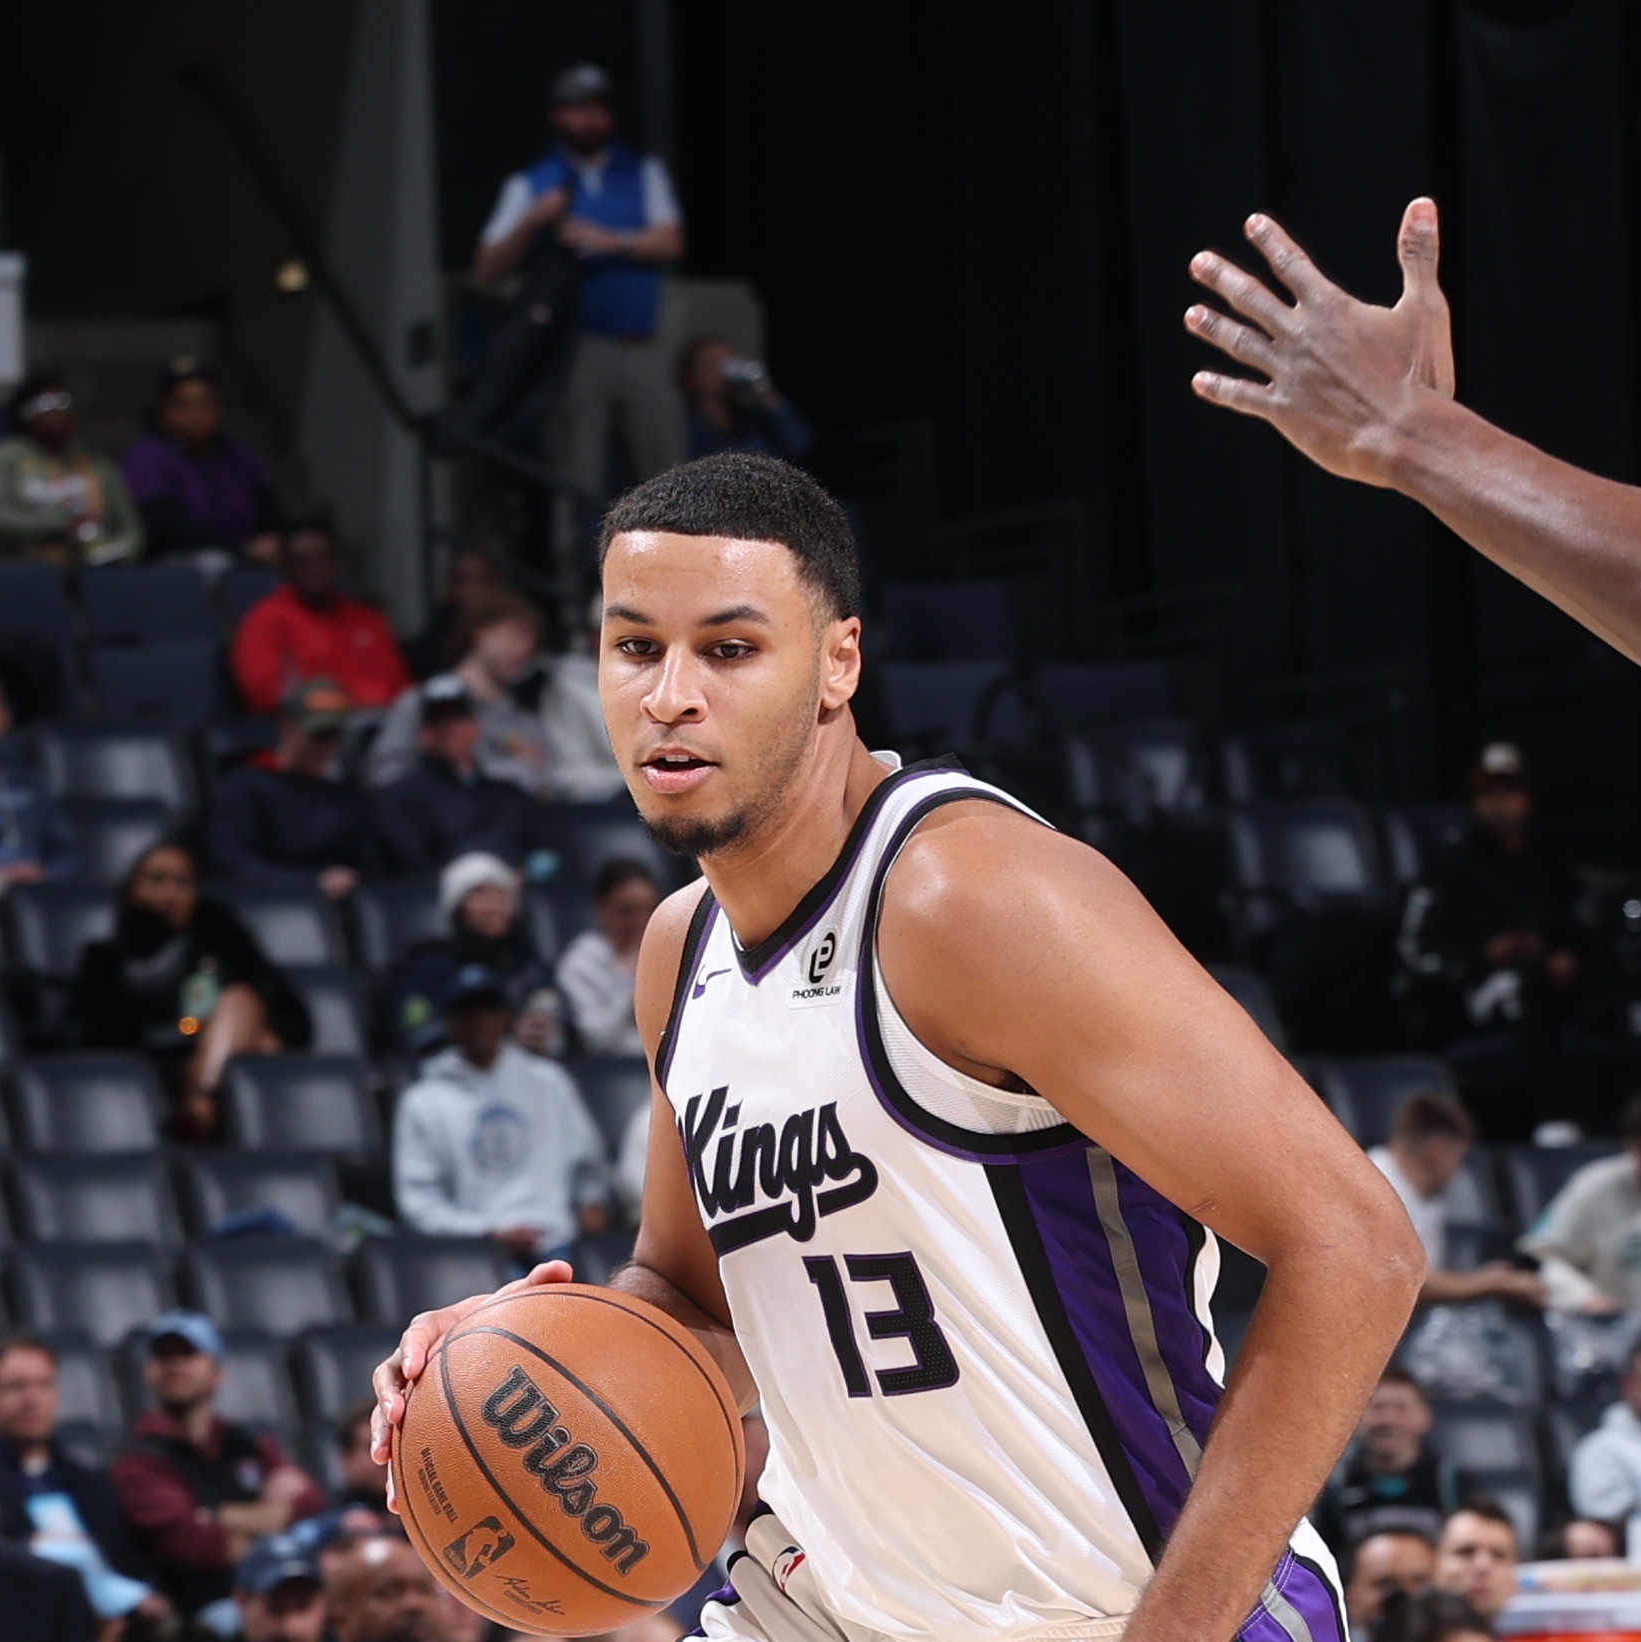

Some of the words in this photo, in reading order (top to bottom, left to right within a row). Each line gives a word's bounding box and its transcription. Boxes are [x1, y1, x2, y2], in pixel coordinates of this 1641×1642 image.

[792, 987, 824, 1000] PHOONG
[825, 985, 842, 997] LAW
[677, 1084, 879, 1258] Kings
[801, 1250, 960, 1398] 13
[432, 1480, 449, 1504] GAME
[480, 1363, 651, 1578] Wilson
